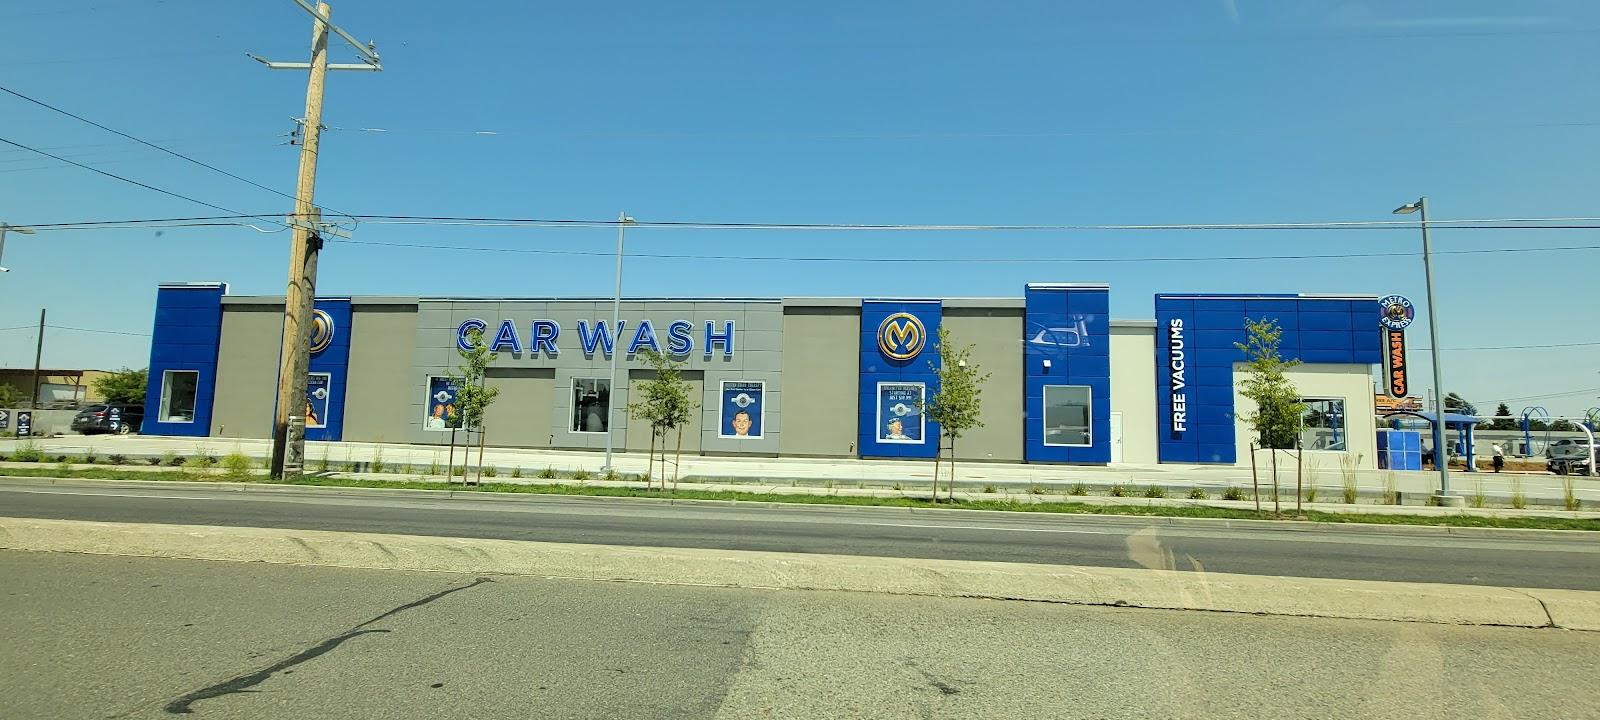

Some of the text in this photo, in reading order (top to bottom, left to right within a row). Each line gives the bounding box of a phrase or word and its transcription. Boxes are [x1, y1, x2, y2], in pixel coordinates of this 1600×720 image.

[1381, 297, 1409, 308] METRO
[456, 318, 736, 356] CAR WASH
[1381, 316, 1412, 328] EXPRESS
[1170, 318, 1187, 432] FREE VACUUMS
[1391, 332, 1405, 395] CAR WASH
